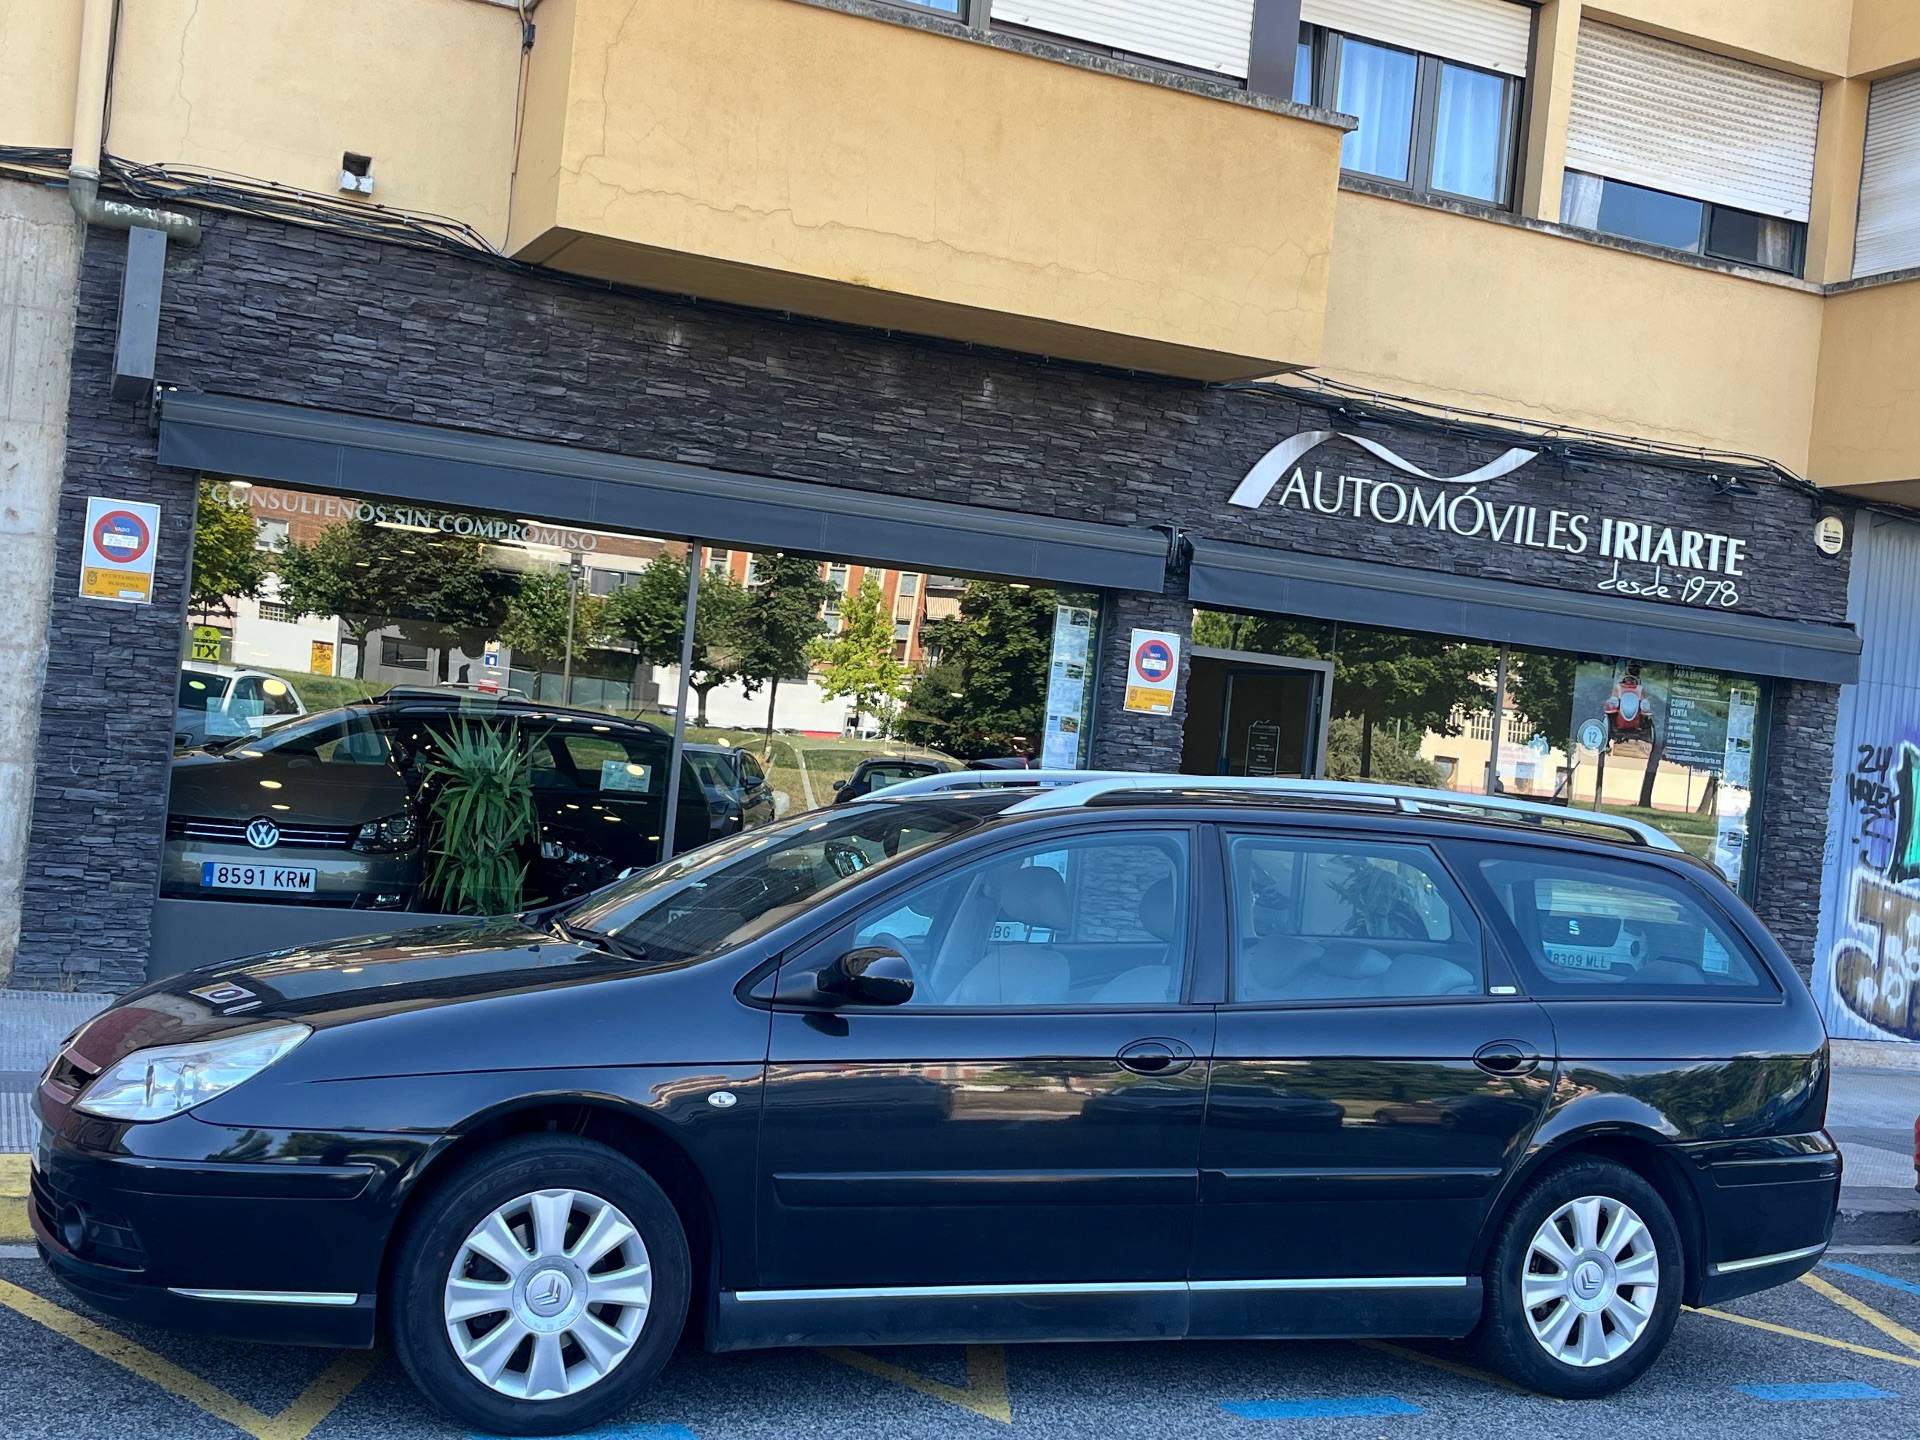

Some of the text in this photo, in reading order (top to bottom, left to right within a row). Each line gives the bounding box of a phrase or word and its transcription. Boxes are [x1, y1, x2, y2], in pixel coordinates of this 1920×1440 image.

[211, 483, 597, 551] CONSULTENOS SIN COMPROMISO
[1278, 466, 1746, 576] AUTOMÓVILES IRIARTE
[1597, 559, 1739, 607] desde 1978
[1669, 707, 1688, 718] VENTA
[1670, 698, 1695, 710] COMPRA
[1588, 731, 1597, 744] 12
[218, 867, 265, 886] 8591
[273, 870, 311, 889] KRM
[1552, 953, 1607, 969] 8309 MLL
